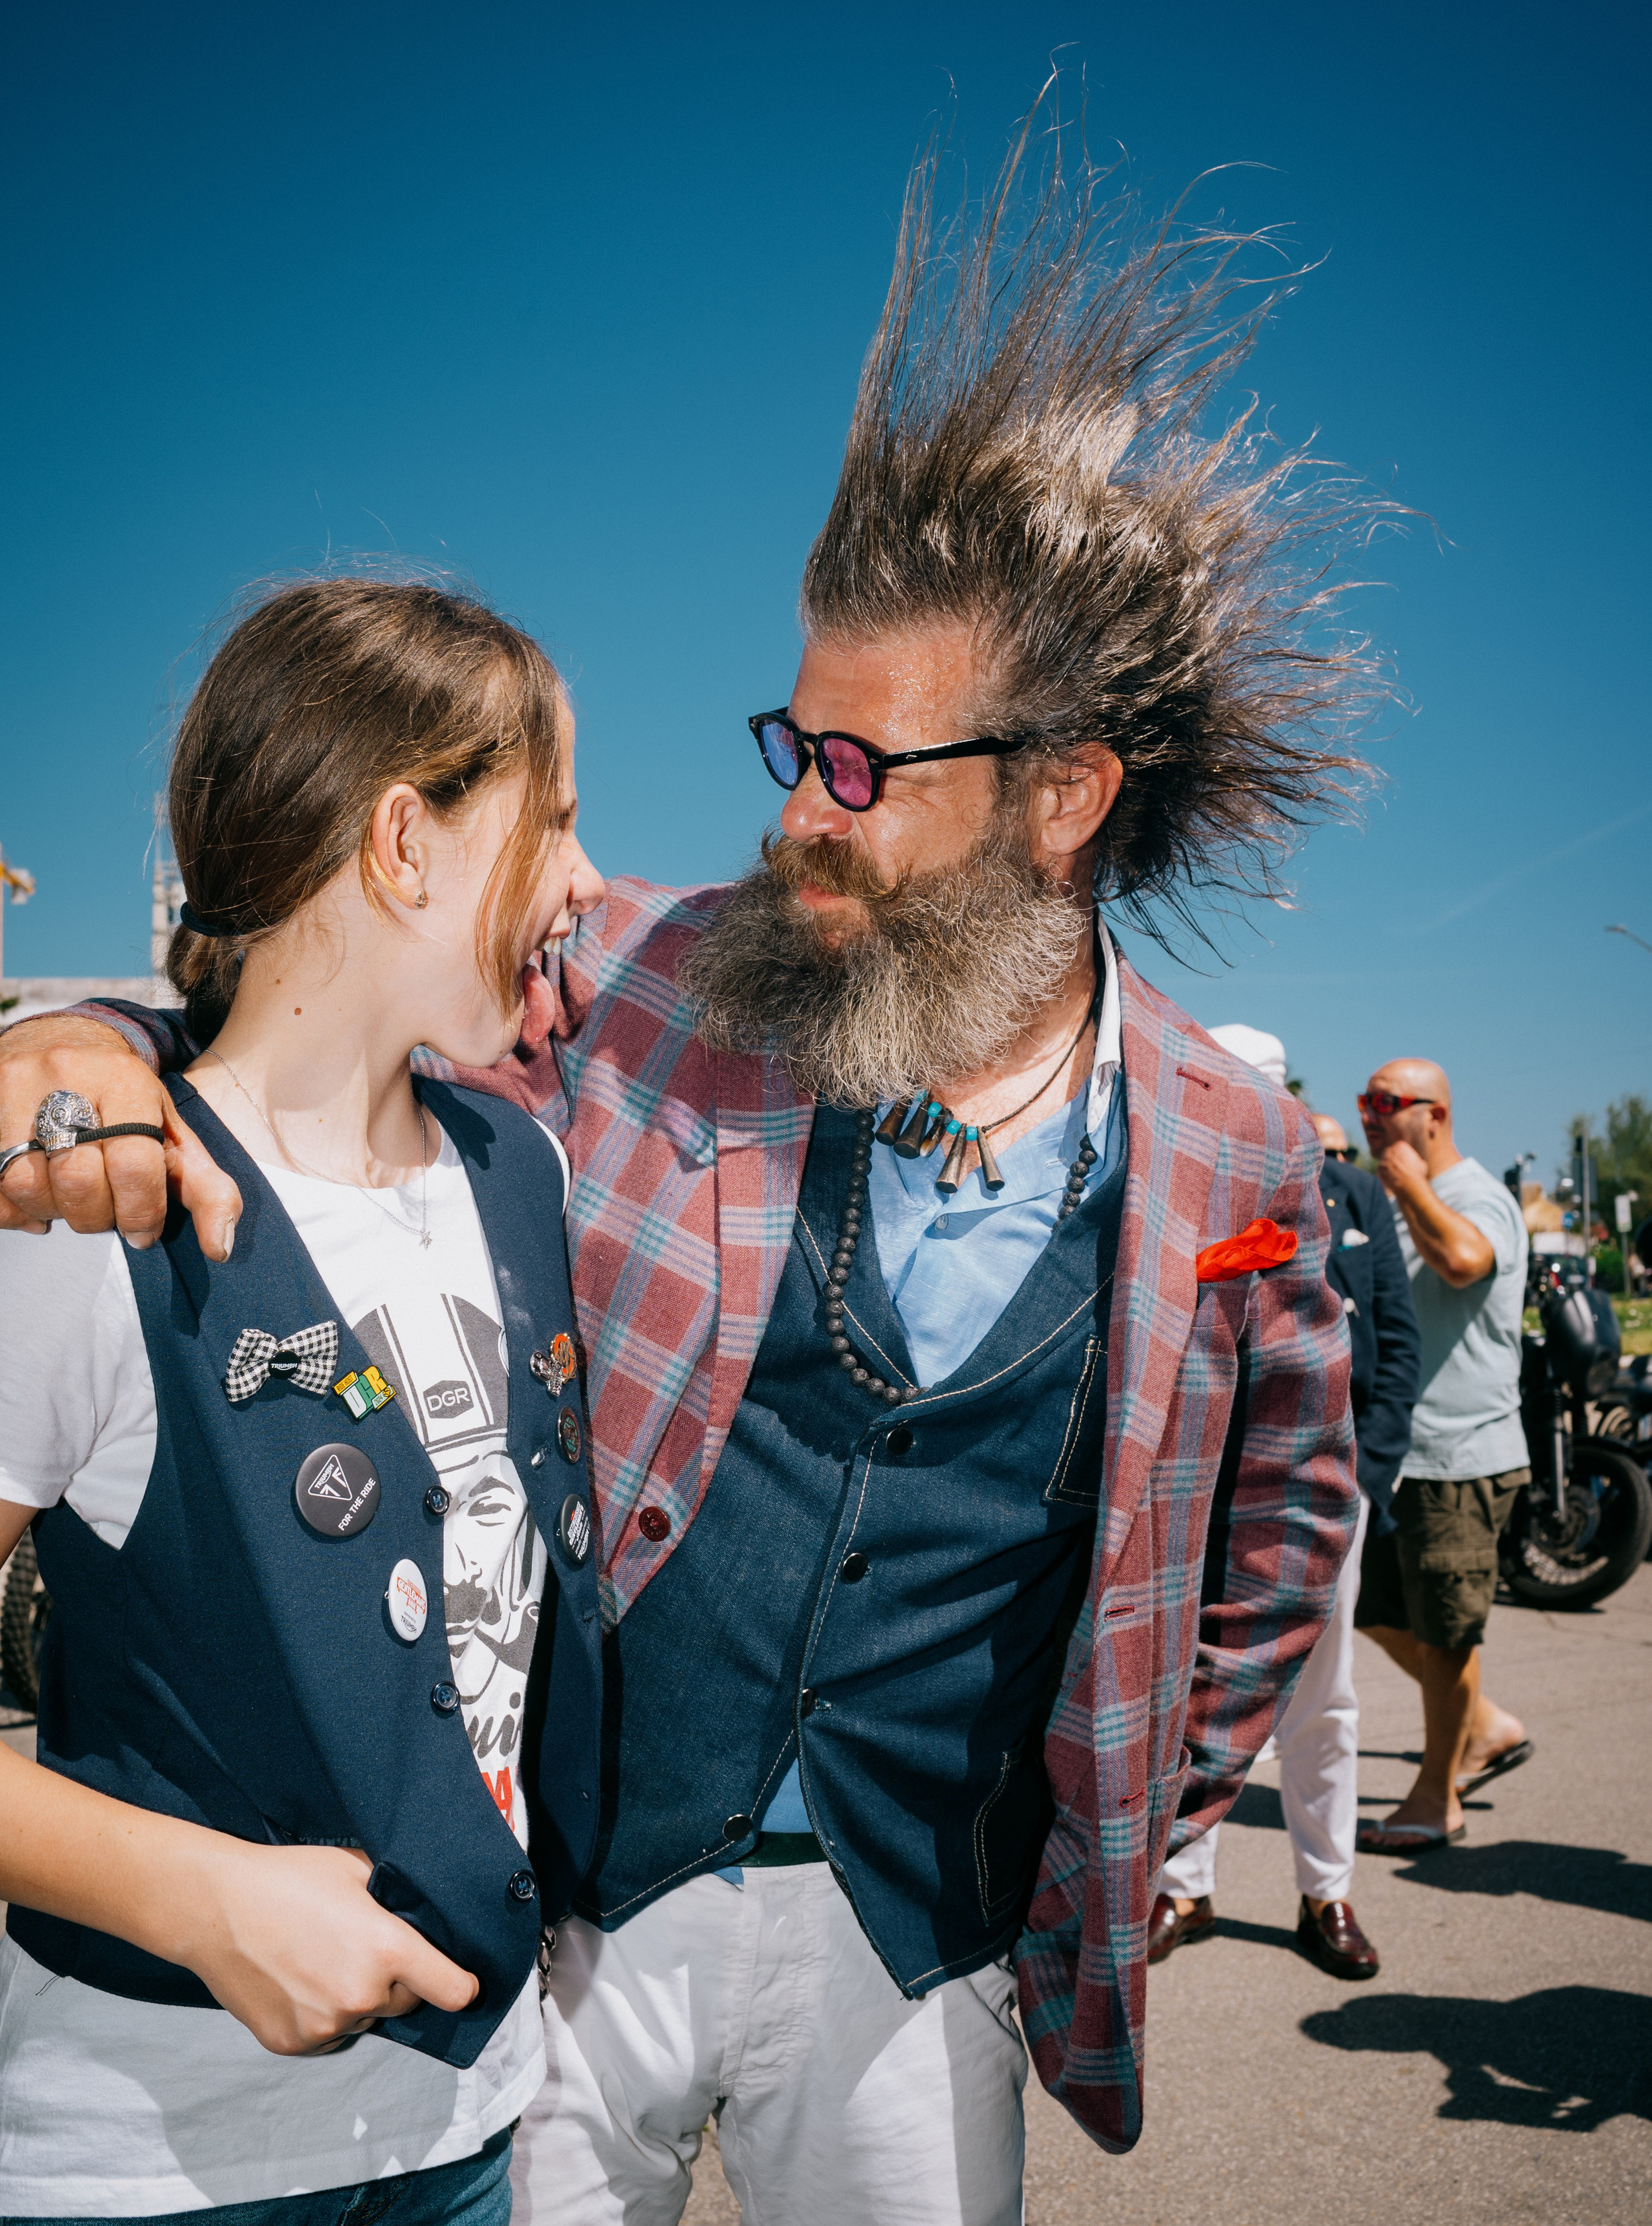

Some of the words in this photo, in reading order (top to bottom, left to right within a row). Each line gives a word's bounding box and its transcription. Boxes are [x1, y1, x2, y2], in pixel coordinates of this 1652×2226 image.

[427, 1388, 470, 1412] DGR
[314, 1463, 335, 1489] TRIUMPH
[337, 1513, 354, 1531] FOR
[348, 1496, 365, 1513] THE
[360, 1477, 376, 1498] RIDE
[578, 1528, 590, 1560] TRIUMPH
[401, 1615, 418, 1634] TRIUMPH
